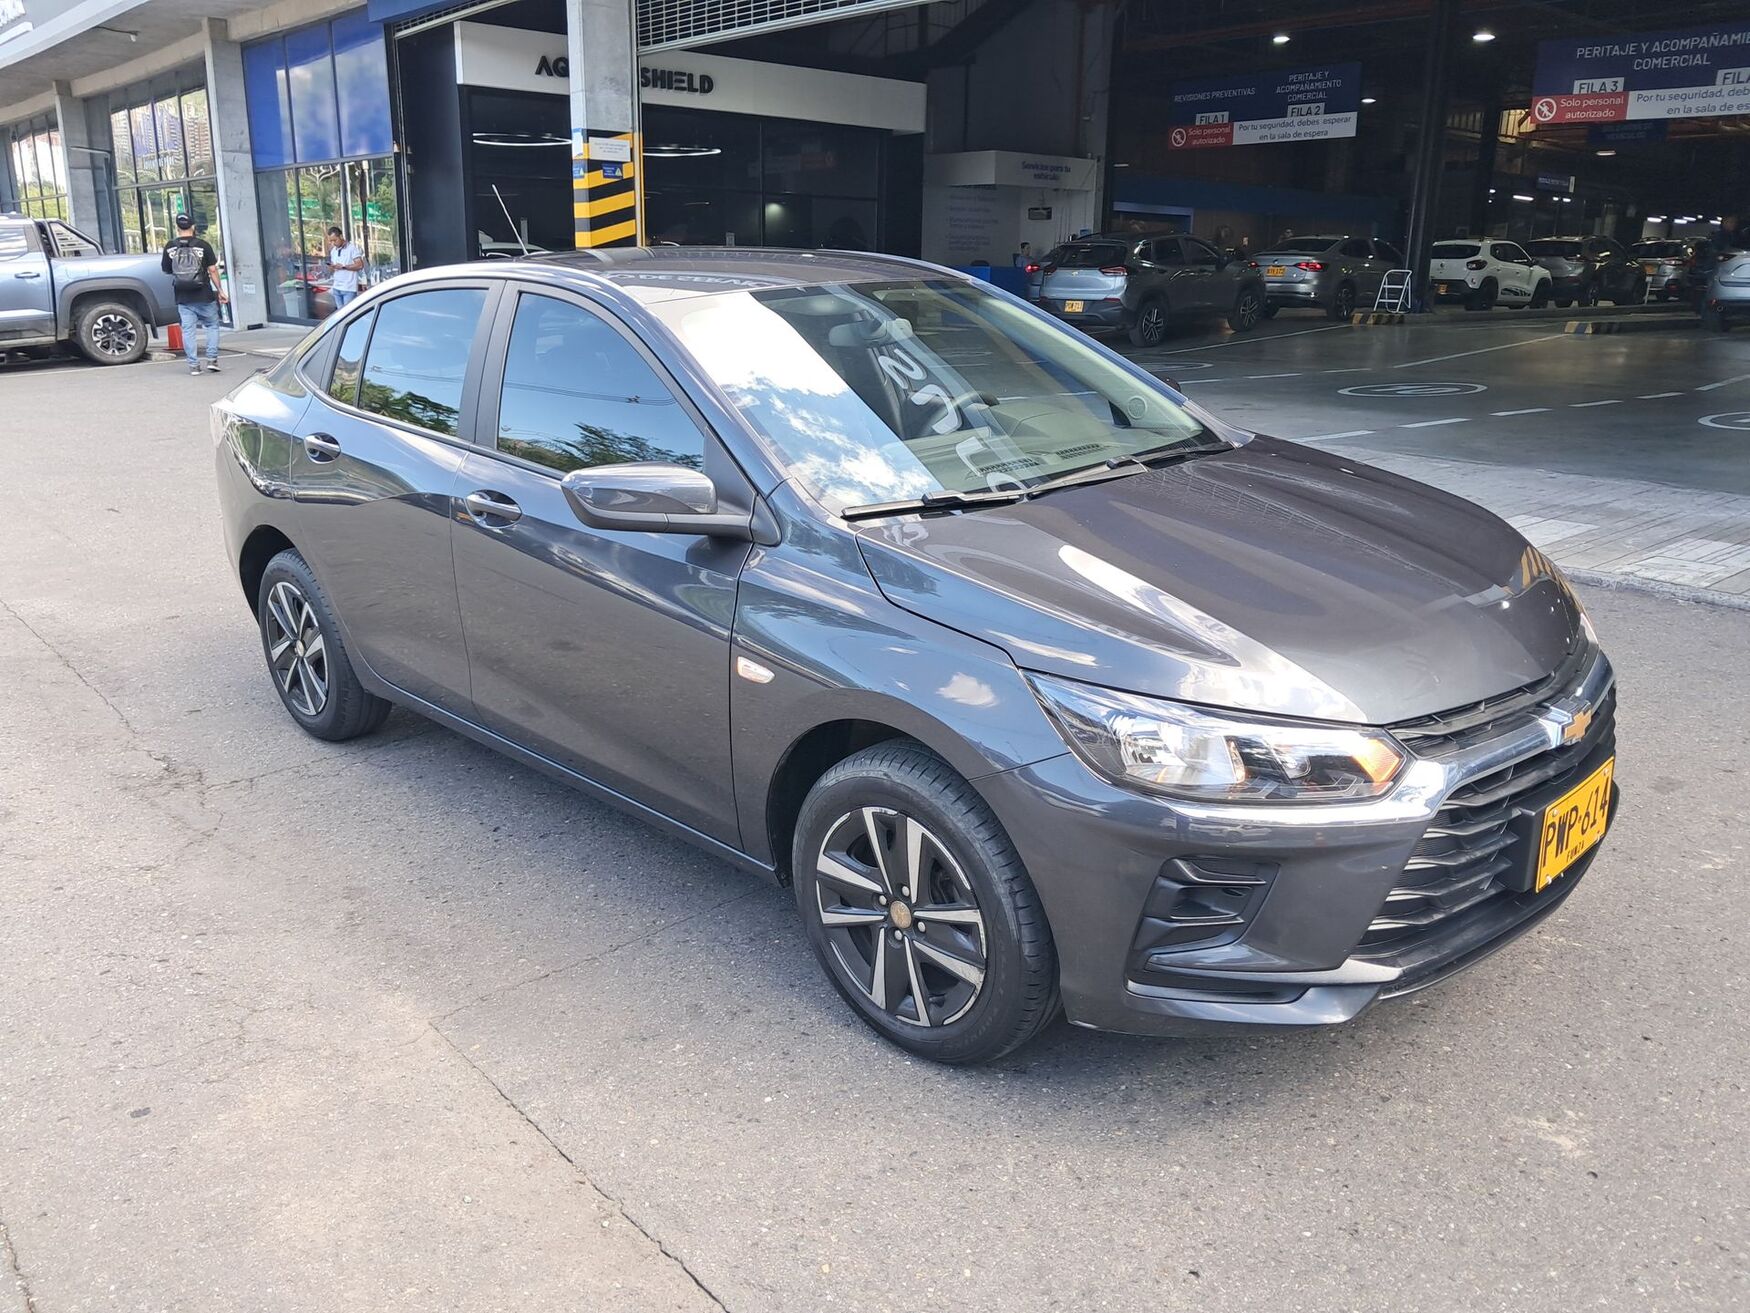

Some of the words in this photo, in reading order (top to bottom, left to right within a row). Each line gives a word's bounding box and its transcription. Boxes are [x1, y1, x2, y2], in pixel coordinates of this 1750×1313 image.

[1576, 42, 1637, 59] PERITAJE
[1640, 42, 1650, 54] Y
[1633, 53, 1711, 70] COMERCIAL
[641, 66, 714, 94] SHIELD
[1288, 72, 1322, 82] PERITAJE
[1323, 71, 1329, 79] Y
[1276, 79, 1342, 94] ACOMPAÑAMIENTO
[1578, 81, 1607, 94] FILA
[1611, 80, 1619, 92] 3
[1174, 91, 1211, 102] REVISIONES
[1211, 87, 1256, 99] PREVENTIVAS
[1287, 91, 1327, 102] COMERCIAL
[1637, 92, 1654, 104] Por
[1655, 92, 1666, 102] tu
[1668, 87, 1725, 103] seguridad,
[1560, 98, 1580, 107] Solo
[1582, 95, 1624, 108] personal
[1291, 106, 1312, 117] FILA
[1314, 105, 1321, 116] 2
[1565, 108, 1615, 119] autorizado
[1667, 107, 1681, 115] en
[1683, 104, 1693, 114] la
[1695, 103, 1717, 114] sala
[1719, 102, 1734, 112] de
[1200, 114, 1219, 124] FILA
[1221, 114, 1225, 123] 1
[1239, 123, 1250, 131] Por
[1297, 118, 1319, 127] debes
[1323, 116, 1351, 126] esperar
[1203, 126, 1231, 136] personal
[1259, 133, 1268, 141] en
[1269, 132, 1276, 140] la
[1277, 131, 1291, 140] sala
[1292, 130, 1302, 139] de
[1303, 129, 1329, 140] espera
[1192, 136, 1226, 145] autorizado
